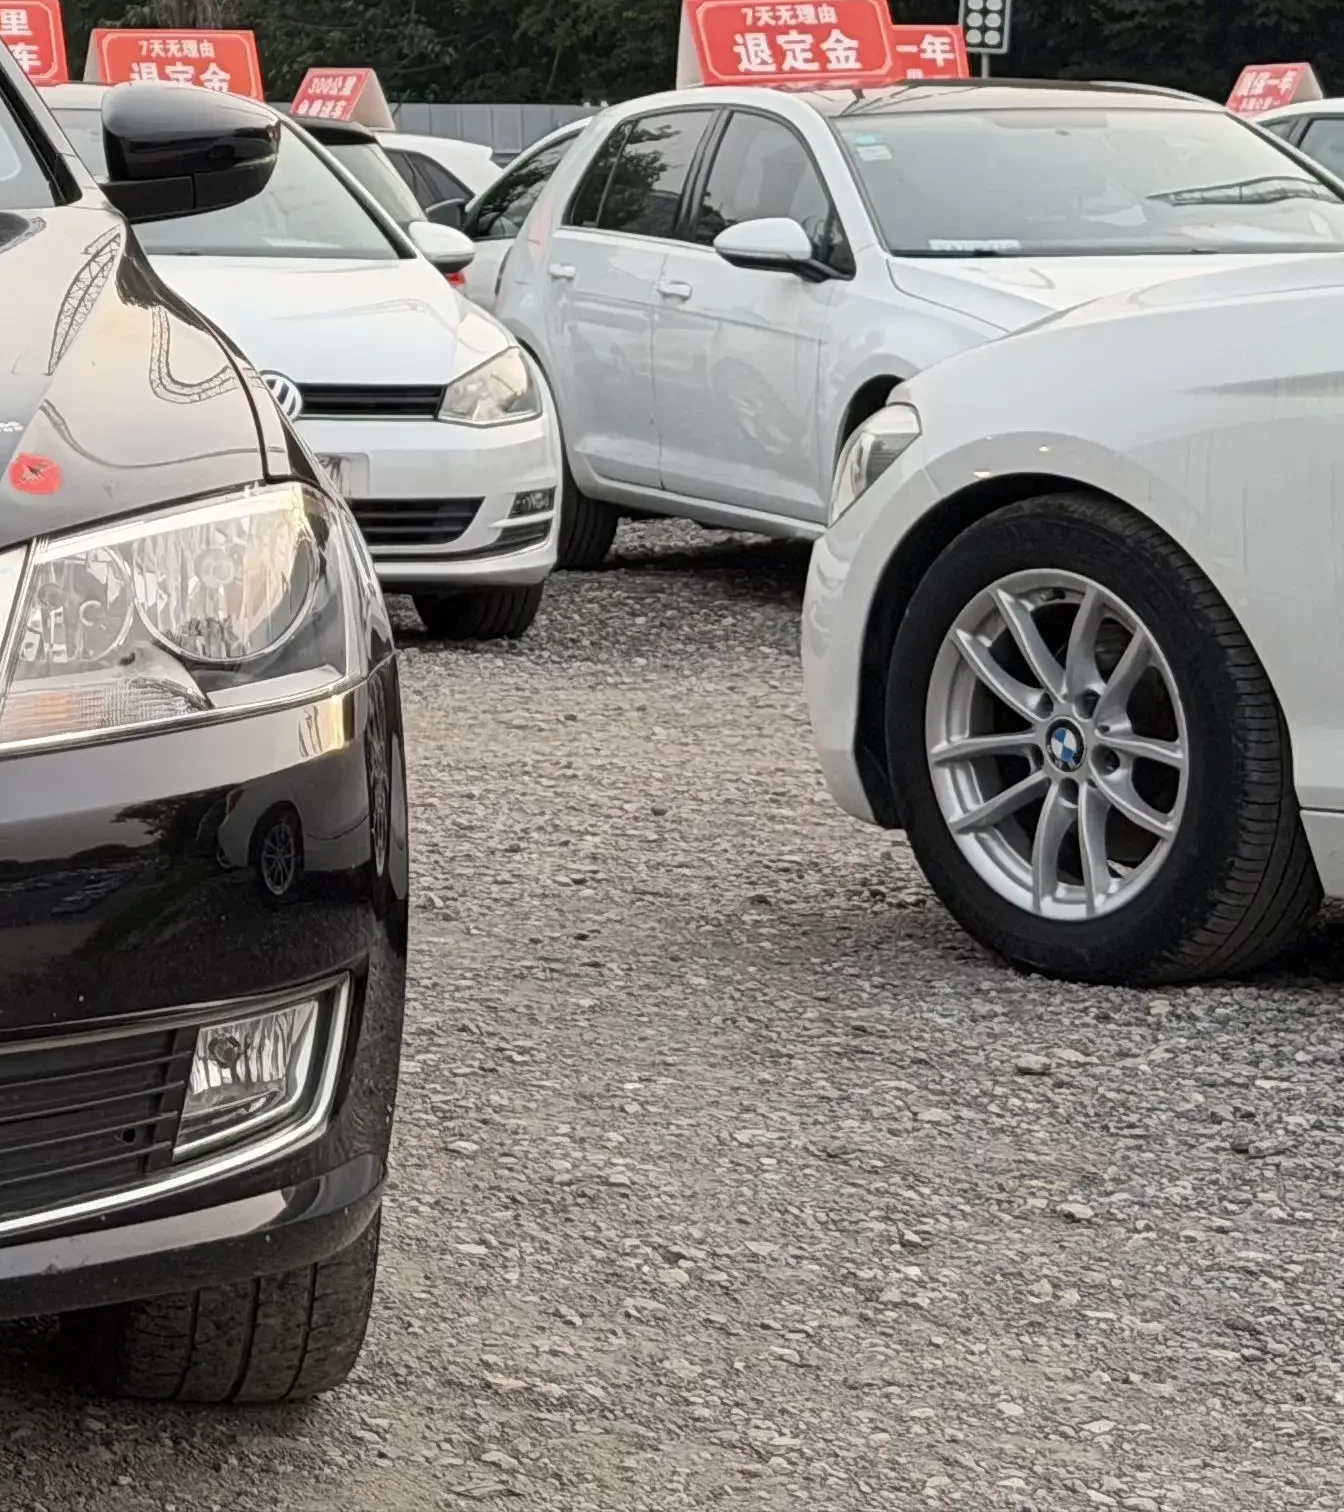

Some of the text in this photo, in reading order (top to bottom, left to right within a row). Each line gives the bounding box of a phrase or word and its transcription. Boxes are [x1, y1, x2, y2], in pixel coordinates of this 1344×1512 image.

[740, 3, 838, 26] 7天无理由
[138, 39, 216, 58] 7天无理由
[732, 28, 862, 72] 退定金
[895, 33, 955, 67] 一年
